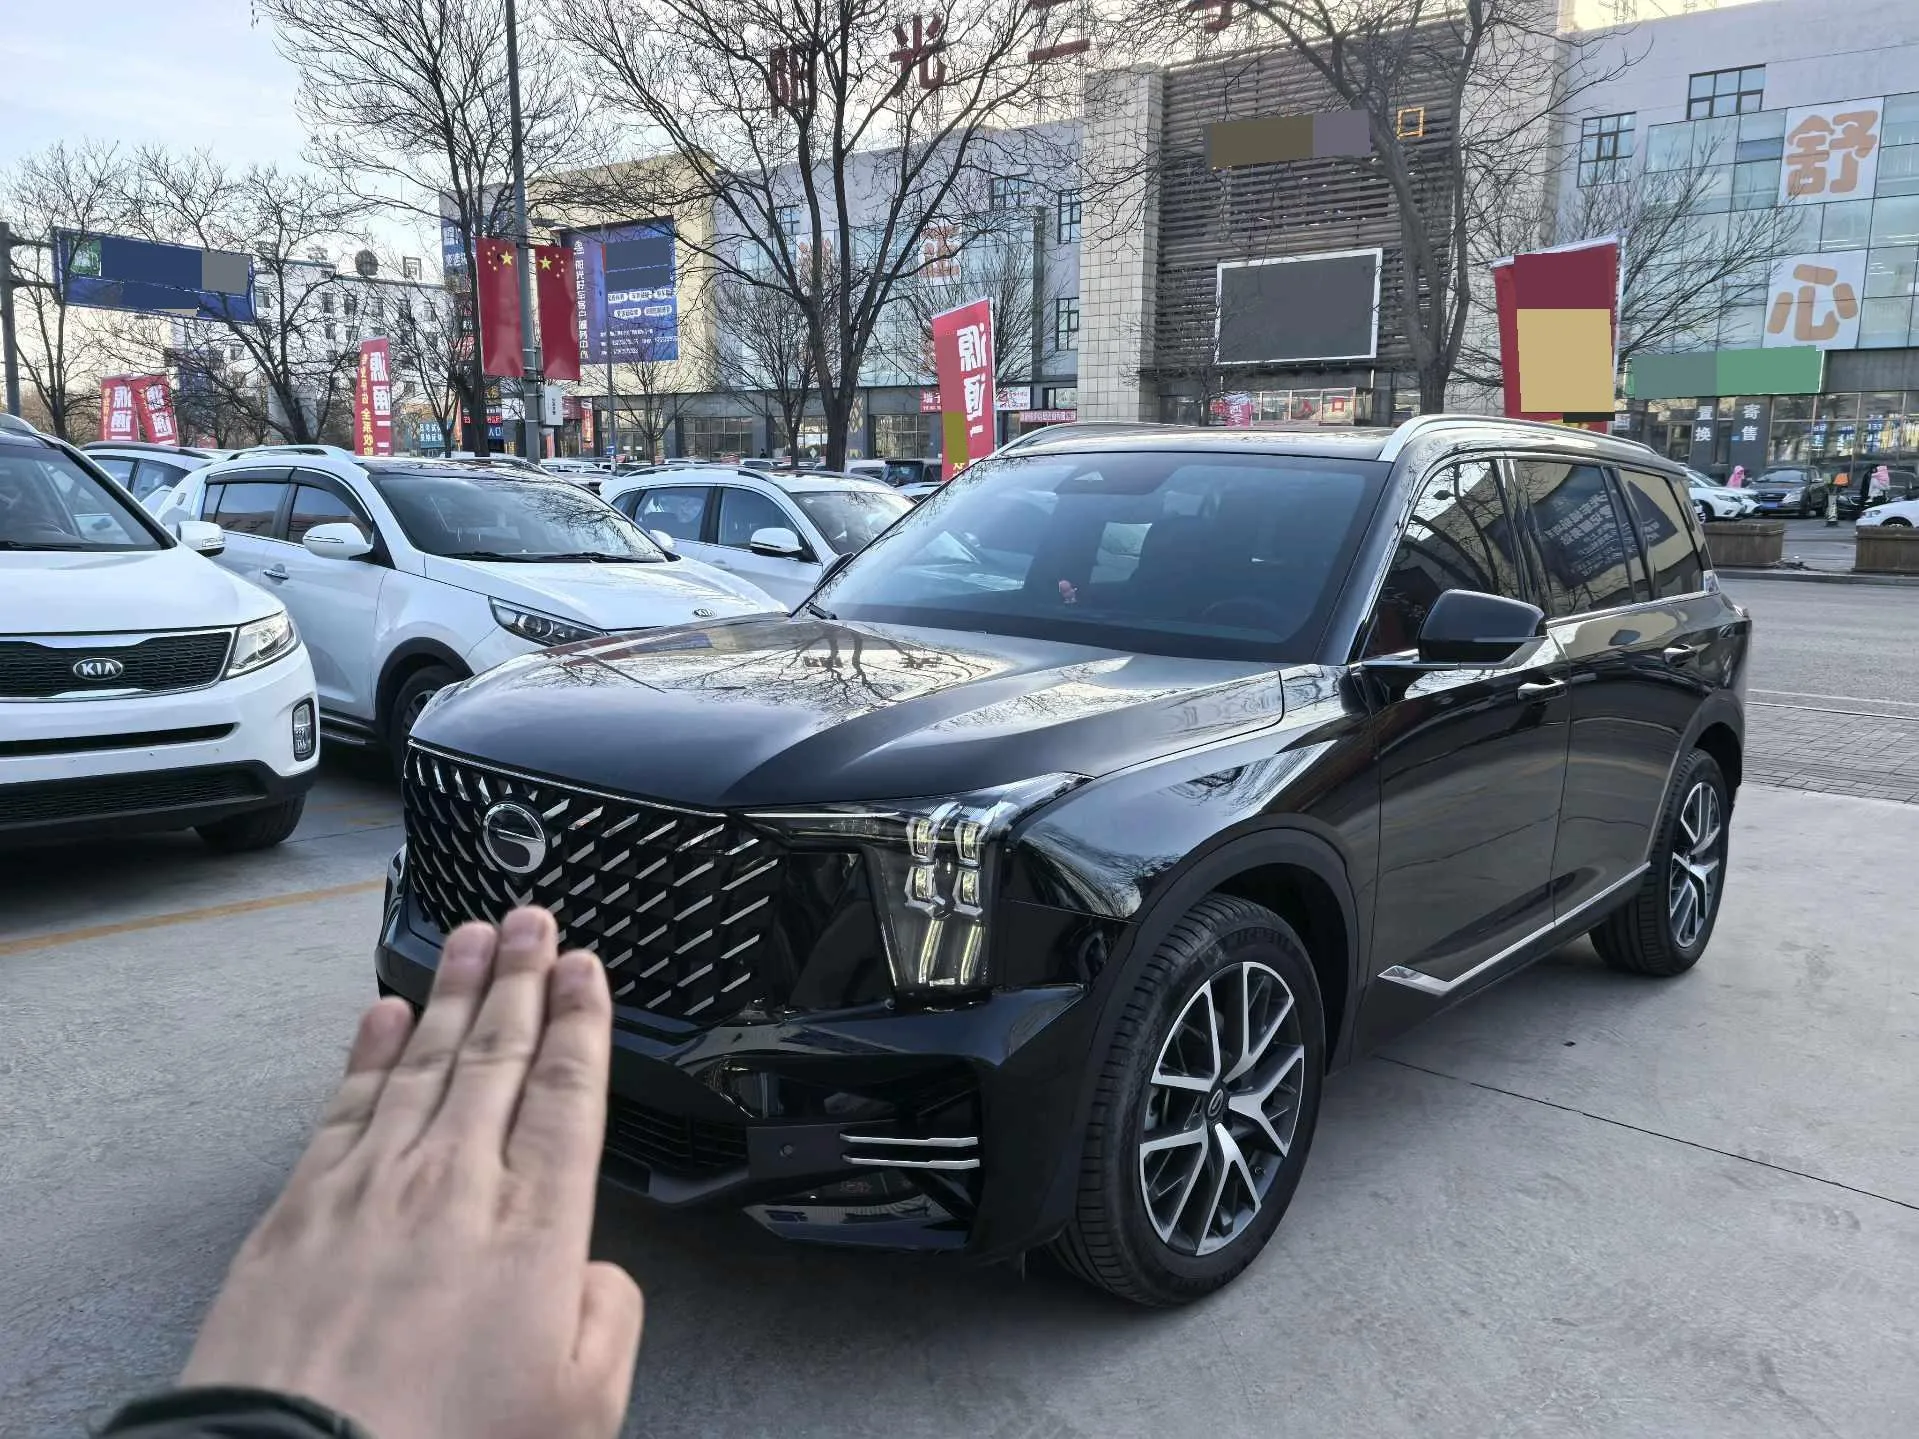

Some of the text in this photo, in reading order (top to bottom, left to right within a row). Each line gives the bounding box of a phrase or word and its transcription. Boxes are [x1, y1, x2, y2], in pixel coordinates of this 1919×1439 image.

[1695, 405, 1713, 442] 置换
[1741, 404, 1761, 441] 寄售
[82, 662, 116, 676] KIA
